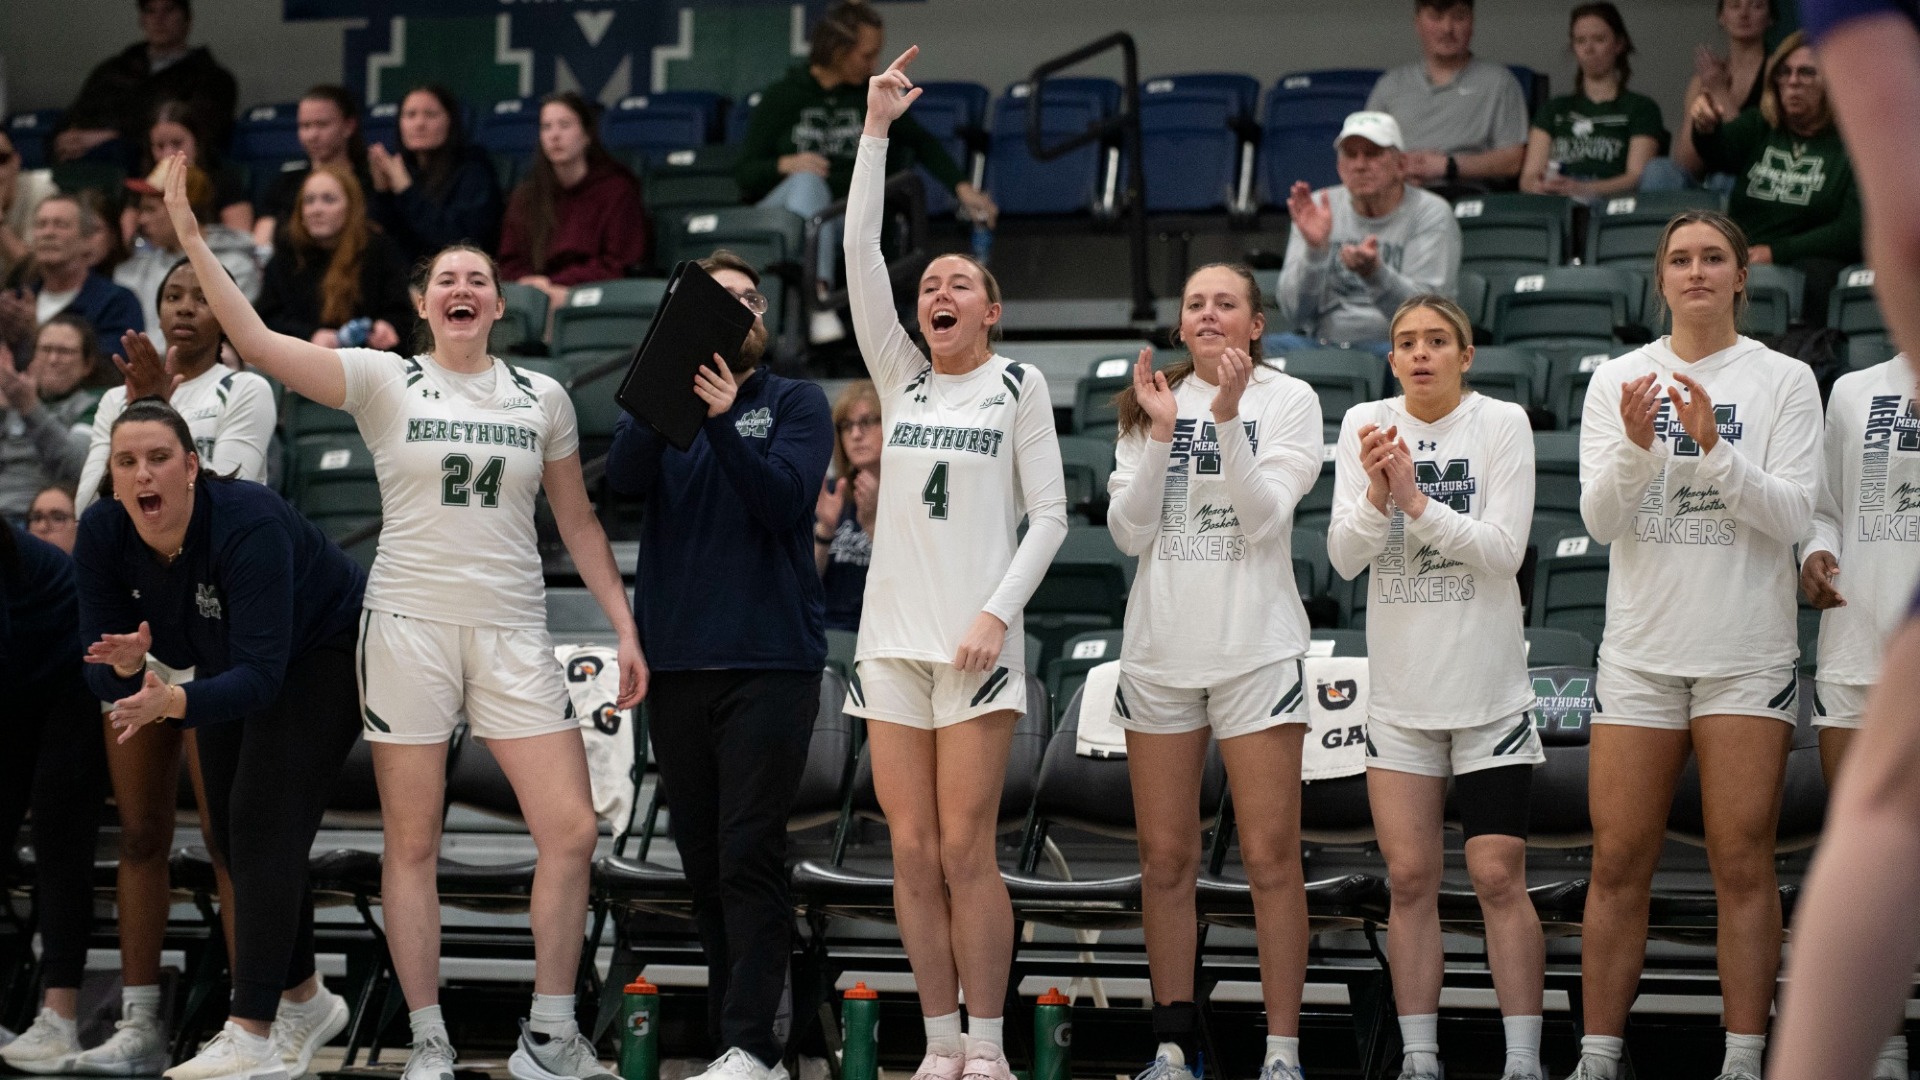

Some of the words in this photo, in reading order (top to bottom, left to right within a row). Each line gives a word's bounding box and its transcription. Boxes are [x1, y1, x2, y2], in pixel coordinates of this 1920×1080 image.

[406, 418, 538, 453] MERCYHURST
[887, 422, 1004, 458] MERCYHURST
[441, 452, 506, 509] 24
[921, 461, 949, 520] 4
[1416, 480, 1474, 493] ERCYHURST
[1669, 484, 1720, 503] Mercyhu
[1674, 498, 1728, 518] Basketba
[1633, 516, 1738, 546] LAKERS
[1858, 514, 1920, 542] LAKE
[1158, 534, 1247, 562] LAKERS
[1377, 573, 1477, 604] LAKERS
[1536, 697, 1594, 708] RCYHURST
